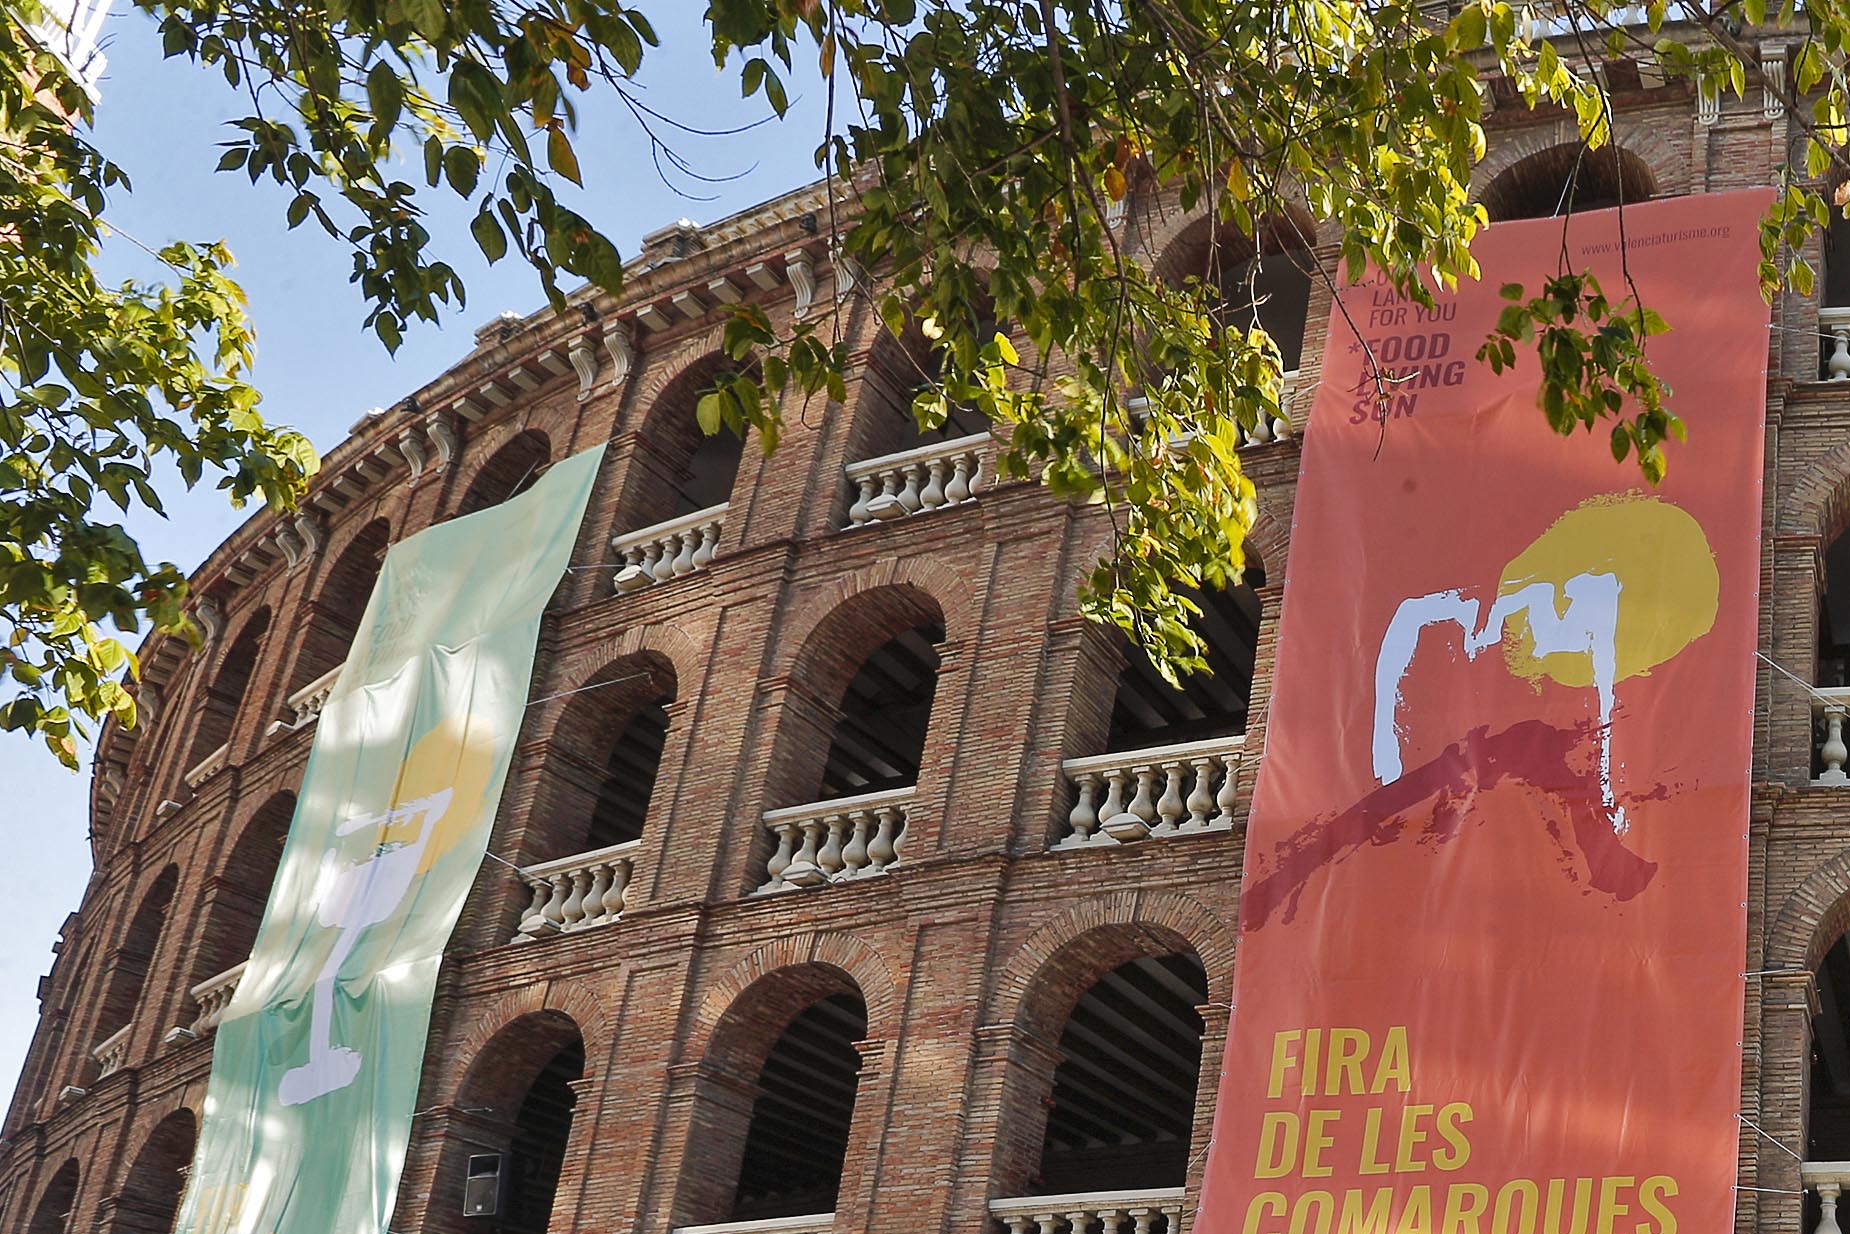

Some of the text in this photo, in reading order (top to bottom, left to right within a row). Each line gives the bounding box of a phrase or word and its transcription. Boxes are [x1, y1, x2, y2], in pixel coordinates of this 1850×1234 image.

[1369, 302, 1457, 329] FOR YOU
[1362, 332, 1450, 367] FOOD
[1266, 1025, 1413, 1099] FIRA
[1253, 1102, 1474, 1180] DE LES
